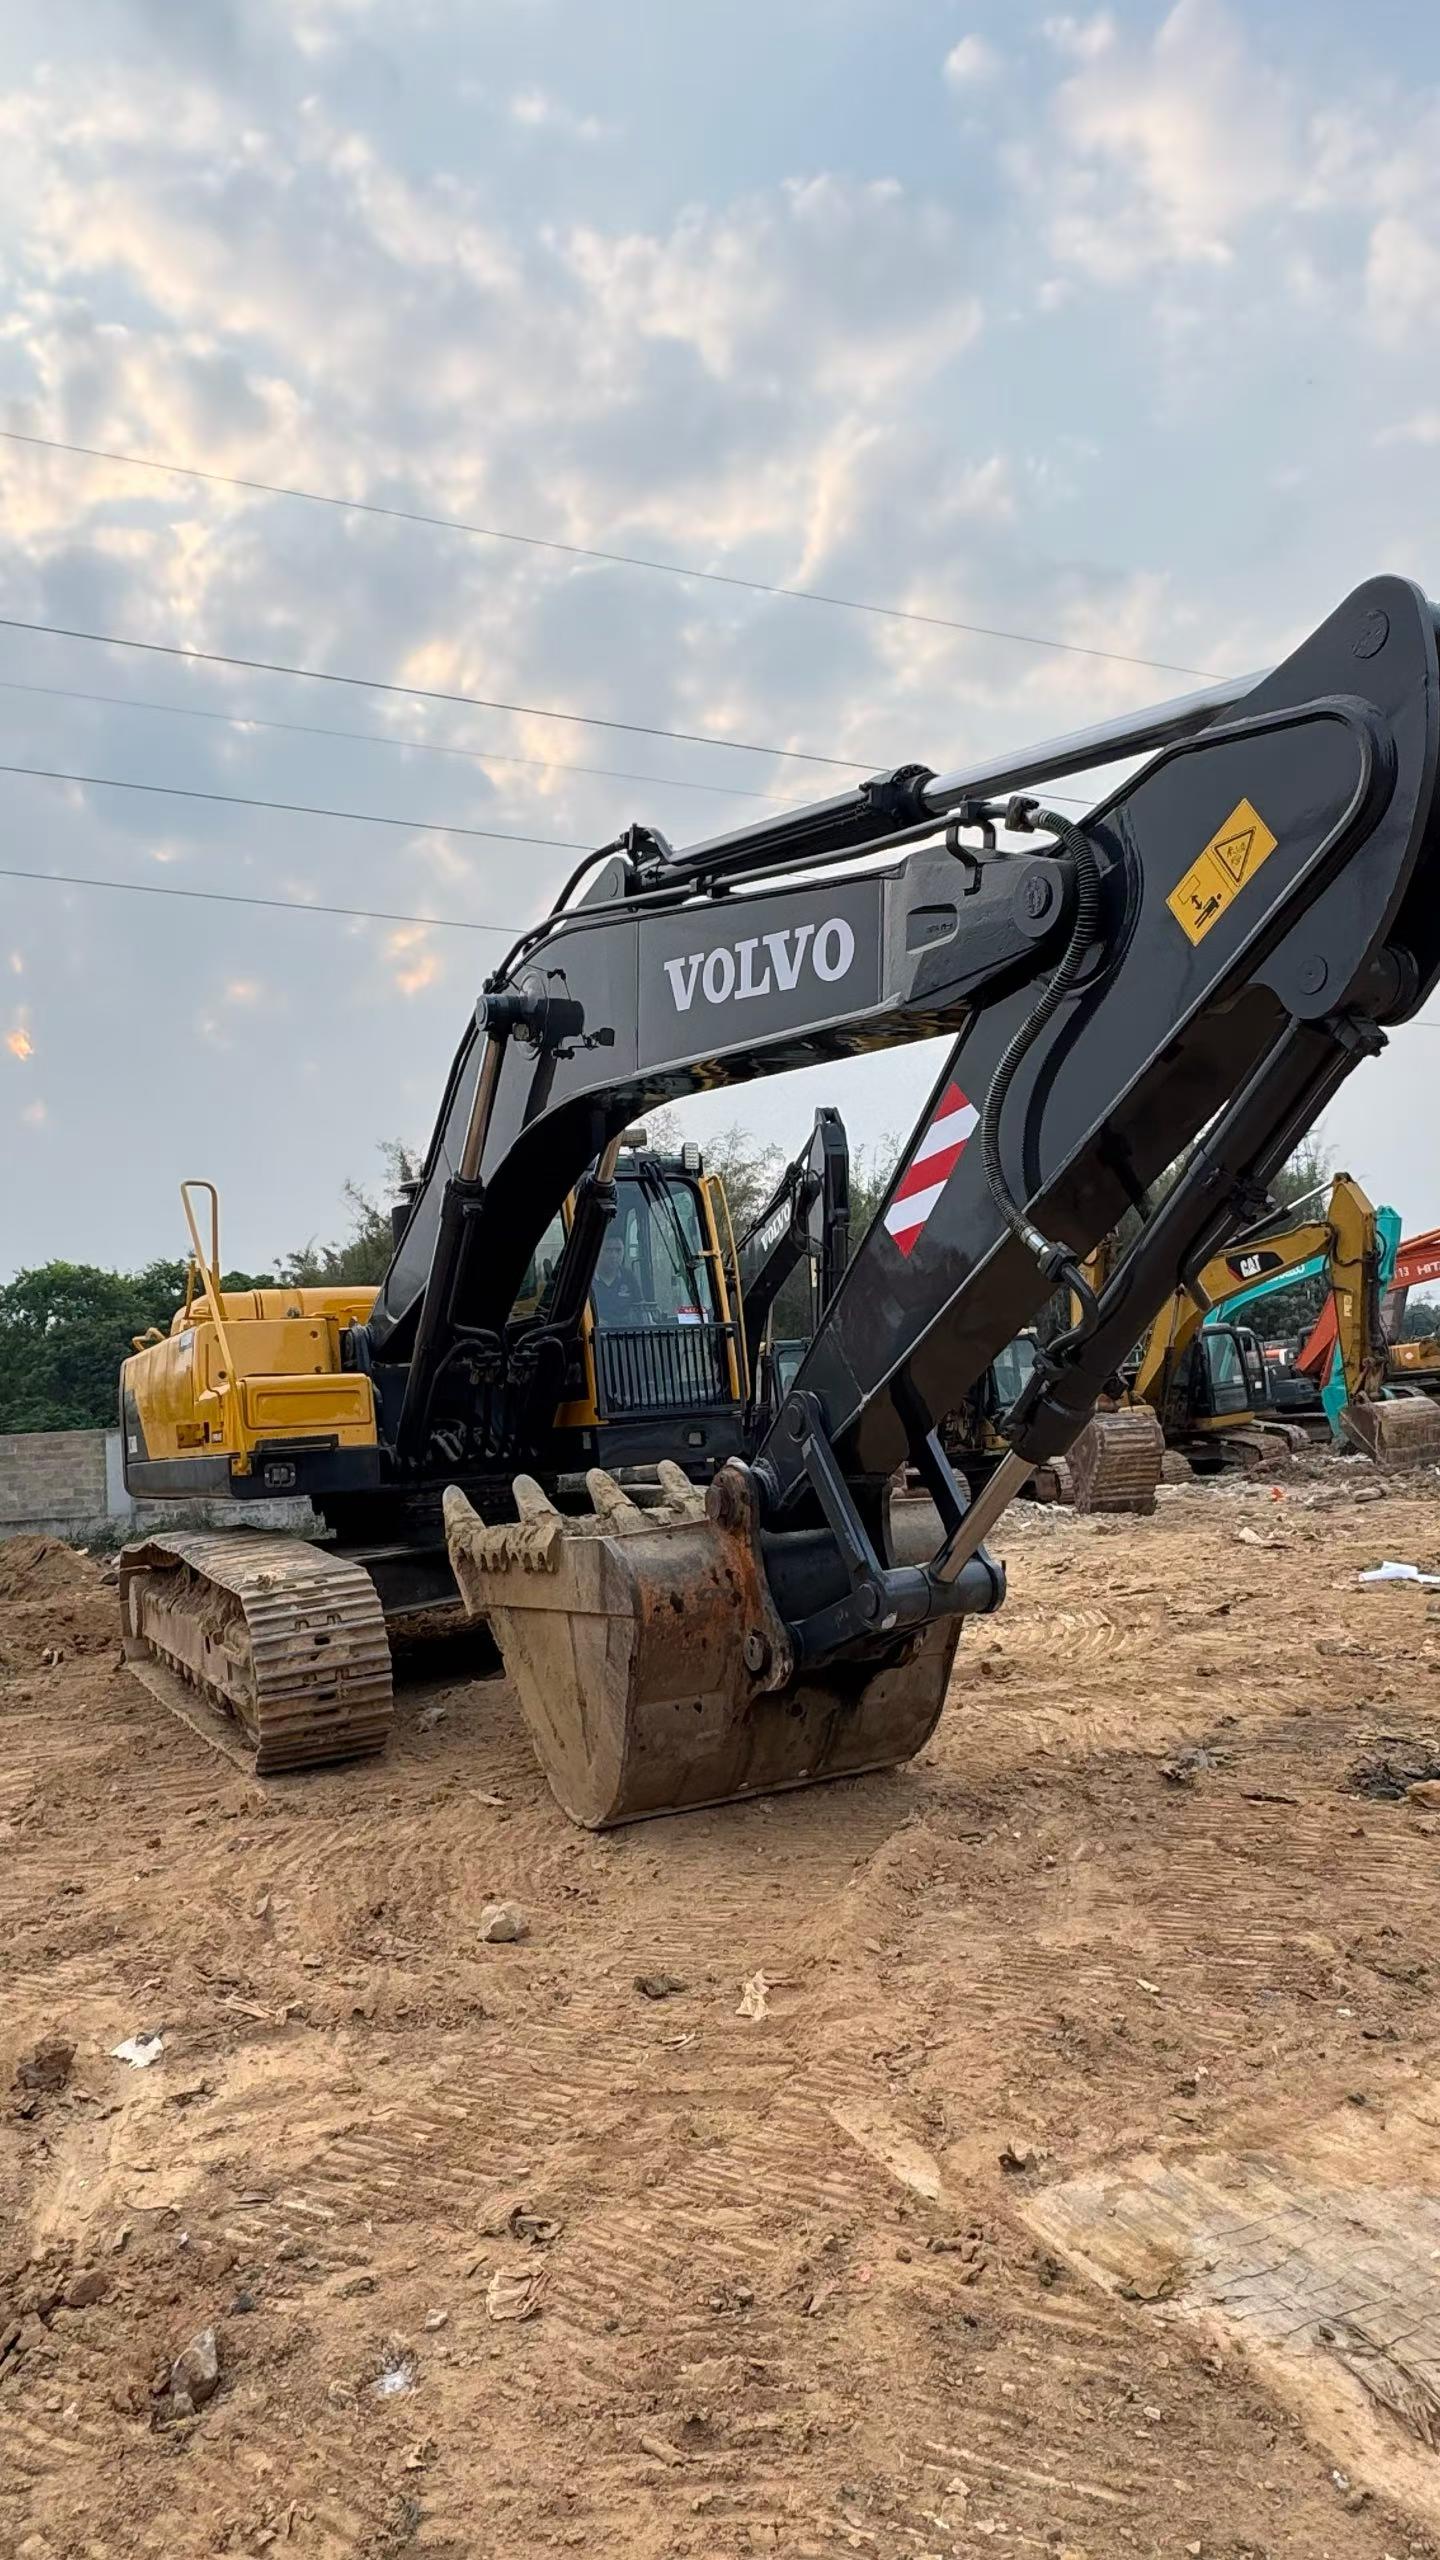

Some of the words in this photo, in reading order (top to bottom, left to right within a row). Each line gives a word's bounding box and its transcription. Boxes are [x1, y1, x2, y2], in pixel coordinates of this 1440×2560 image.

[664, 918, 855, 1011] VOLVO
[761, 1203, 791, 1251] VOLVO
[1240, 1254, 1261, 1277] CAT
